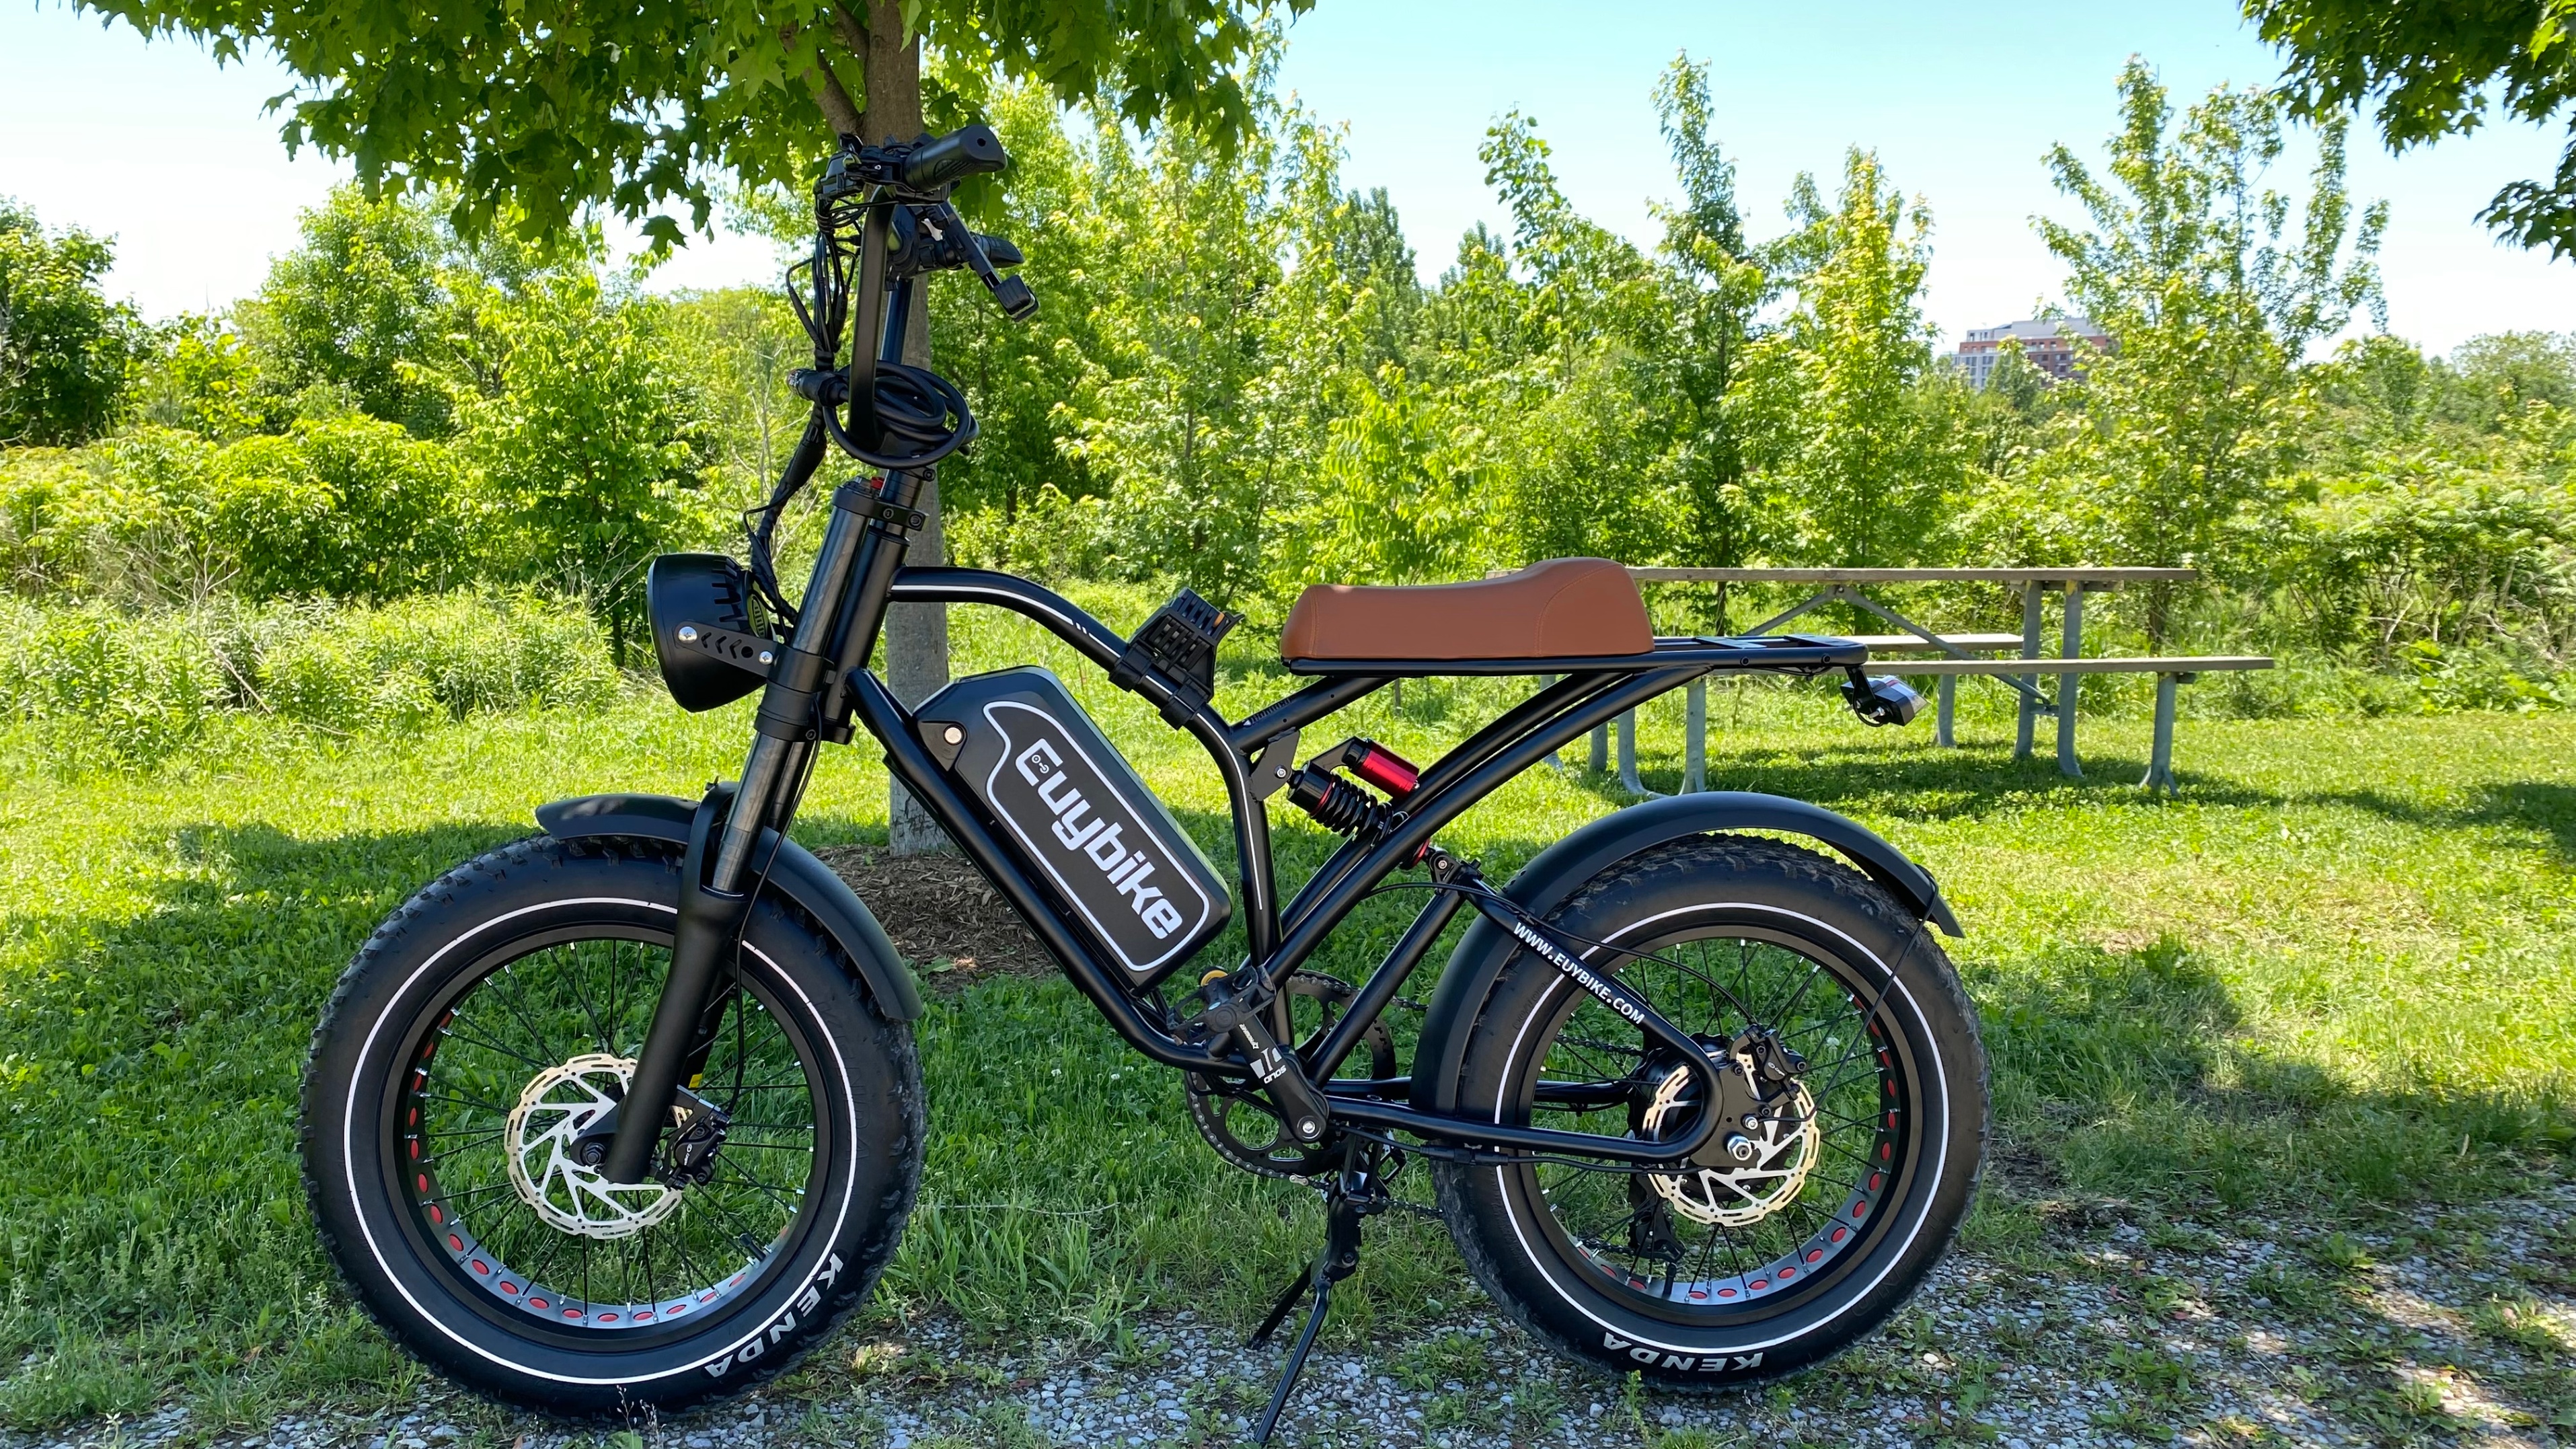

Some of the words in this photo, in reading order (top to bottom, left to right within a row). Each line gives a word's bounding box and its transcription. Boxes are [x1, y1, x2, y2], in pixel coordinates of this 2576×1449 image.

[1016, 738, 1183, 939] Euybike
[1513, 922, 1646, 1025] WWW.EUYBIKE.COM
[704, 1252, 844, 1378] KENDA
[1603, 1331, 1764, 1372] KENDA
